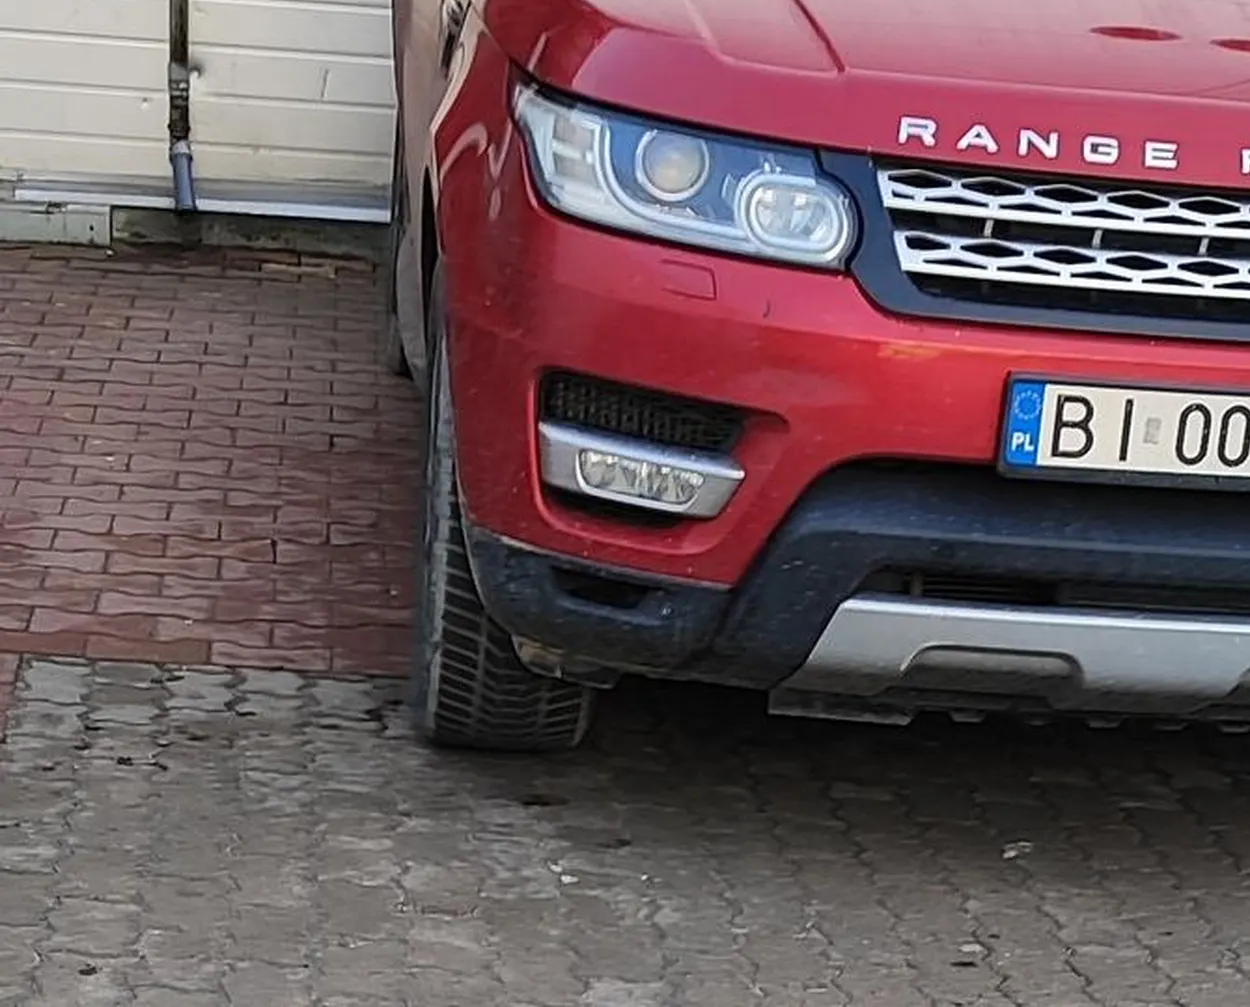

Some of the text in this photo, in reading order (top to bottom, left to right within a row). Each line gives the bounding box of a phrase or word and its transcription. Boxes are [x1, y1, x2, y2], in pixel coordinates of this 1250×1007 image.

[898, 116, 1179, 169] RANGE
[1011, 431, 1035, 452] PL
[1051, 394, 1134, 462] BI
